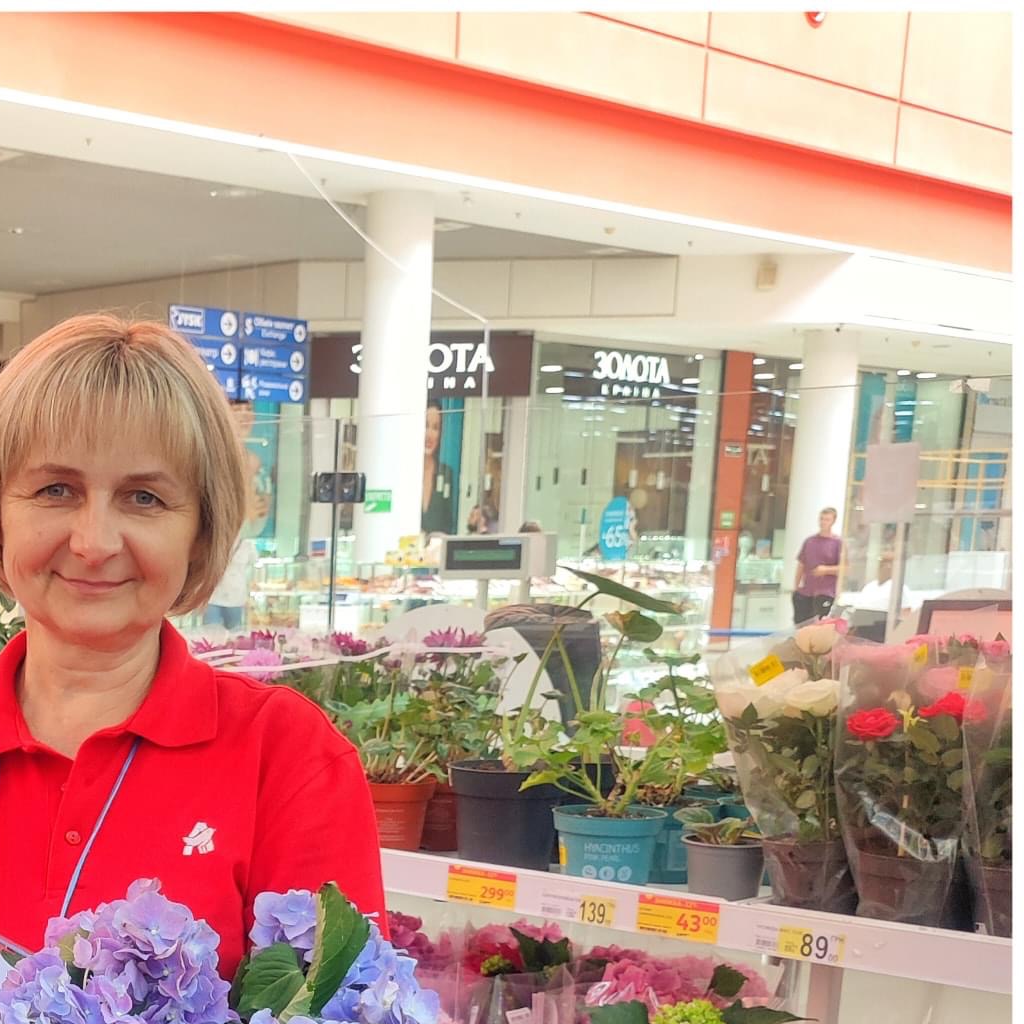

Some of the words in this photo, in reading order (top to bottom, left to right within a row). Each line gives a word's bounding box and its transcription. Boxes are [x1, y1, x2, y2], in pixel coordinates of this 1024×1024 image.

[592, 351, 671, 384] ЗОЛОТА
[480, 885, 504, 900] 299
[579, 901, 606, 925] 139
[675, 912, 701, 933] 43
[800, 933, 829, 960] 89
